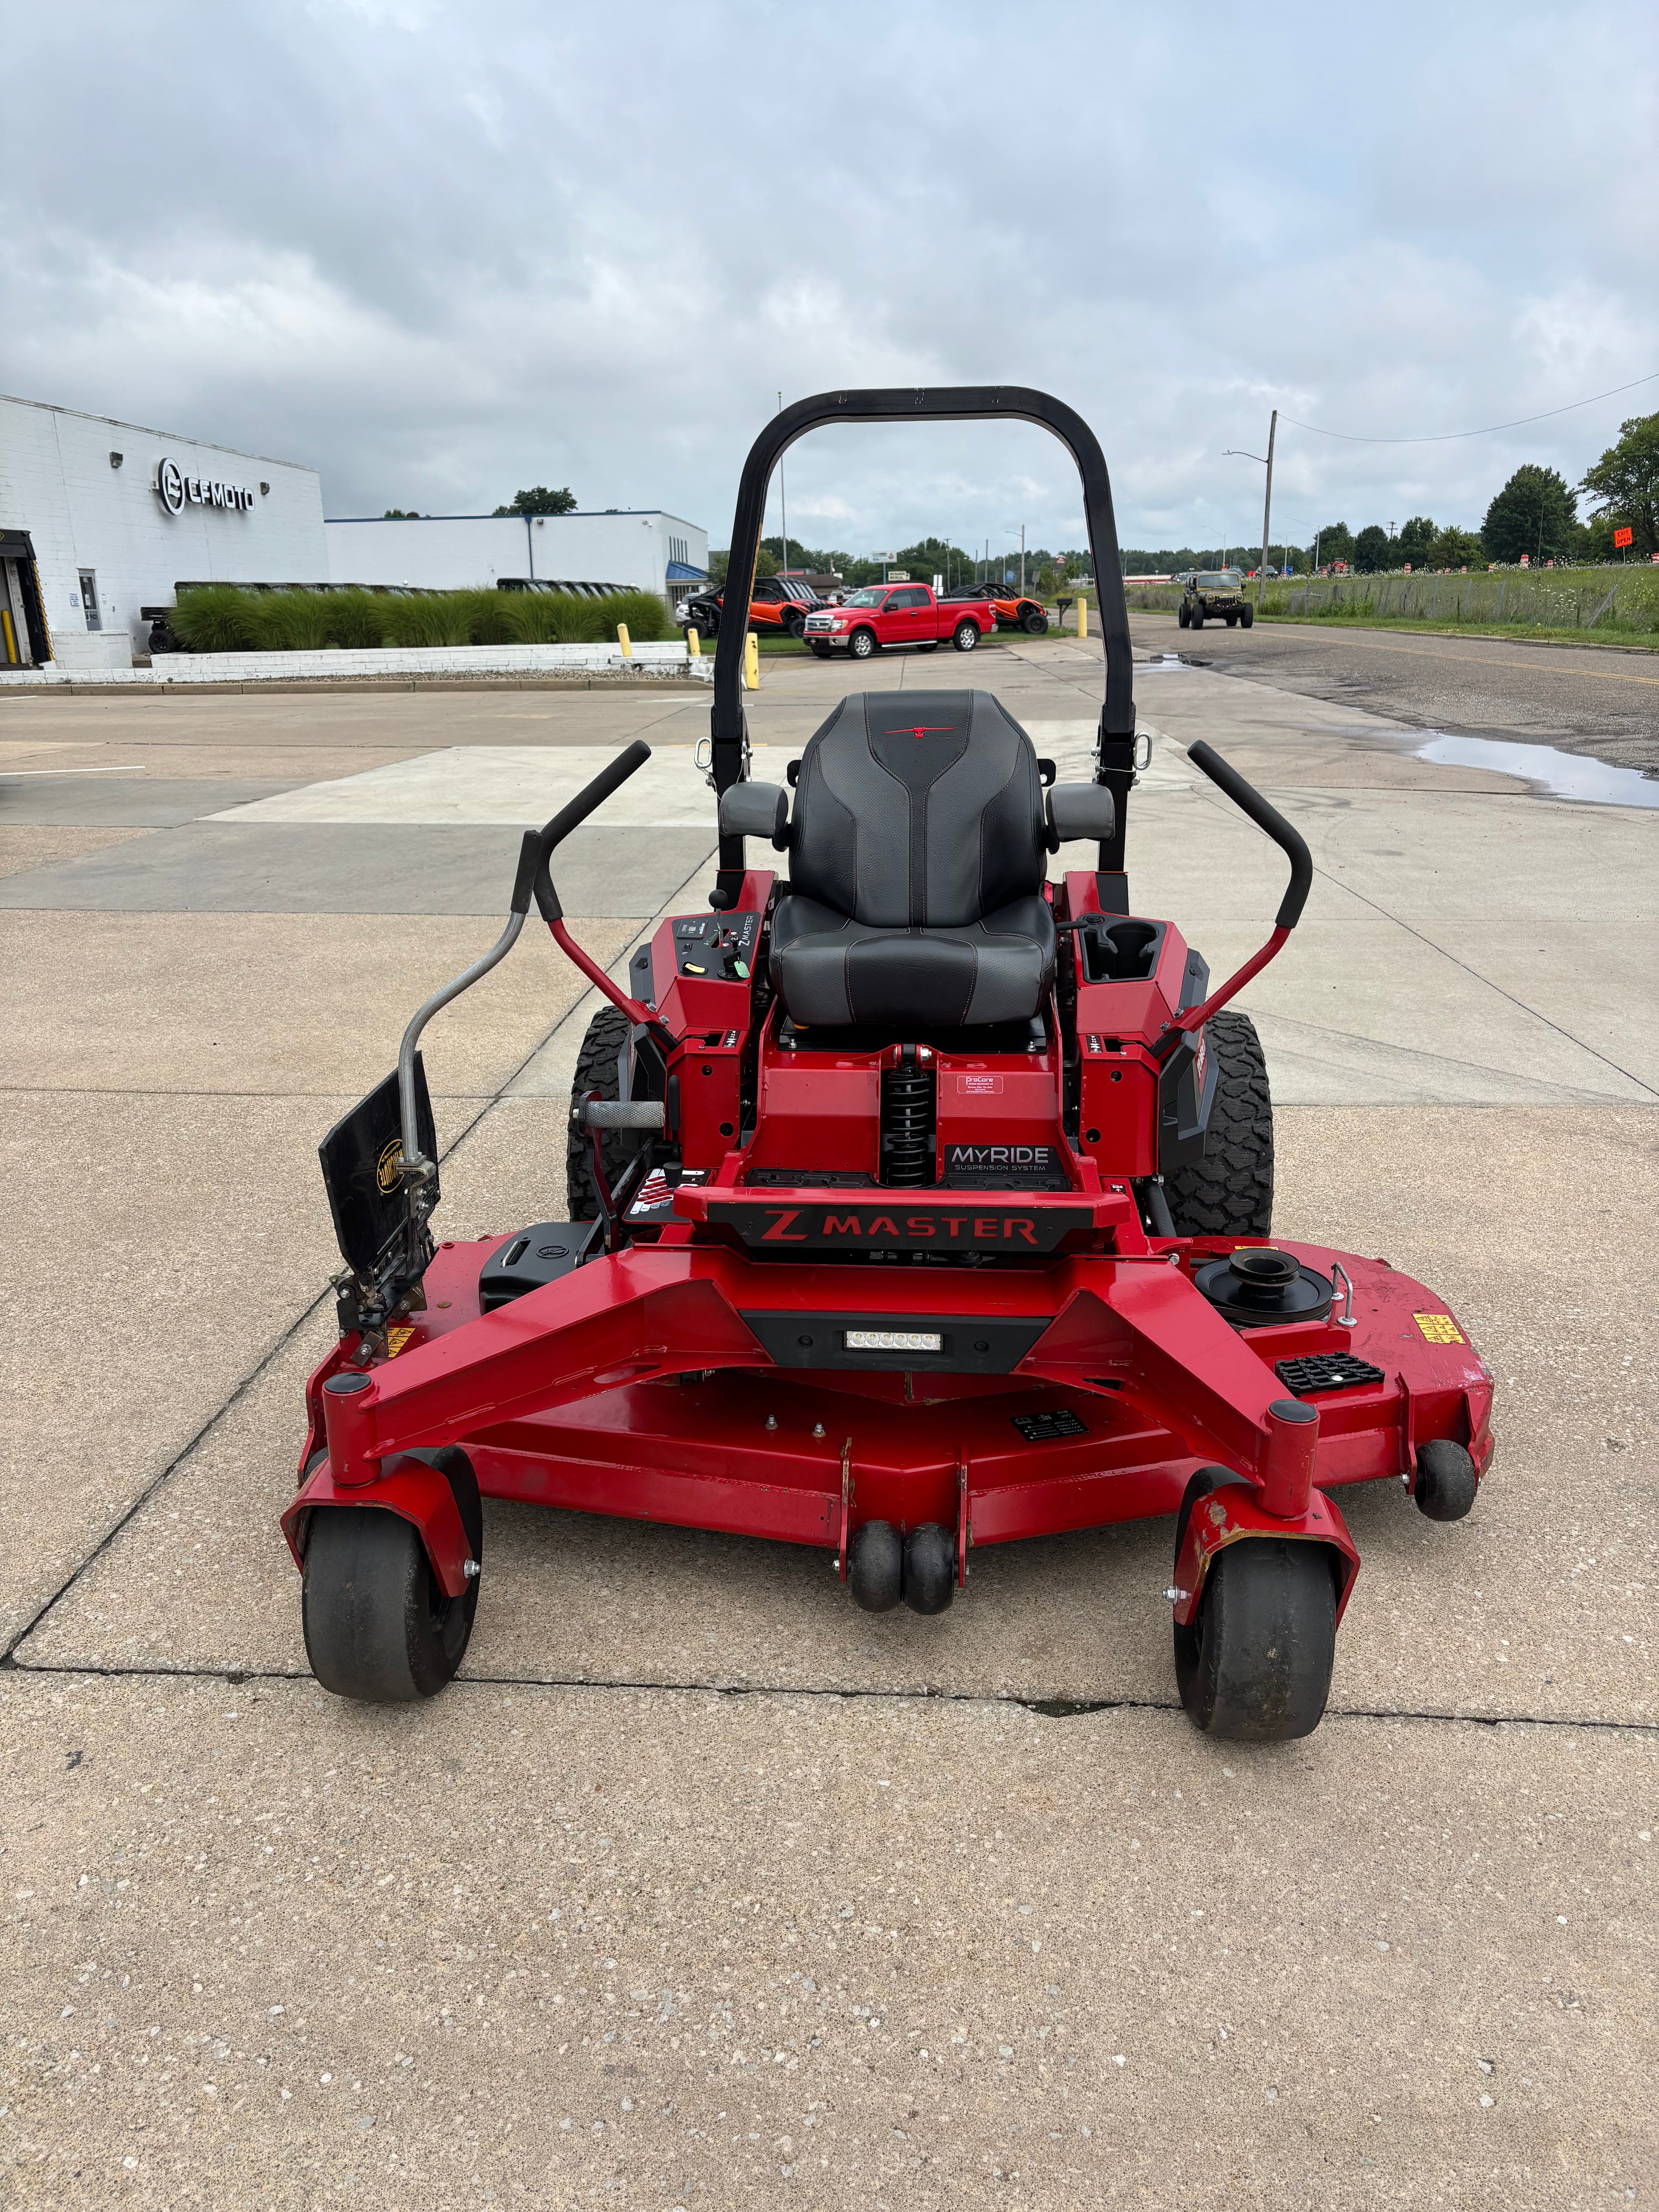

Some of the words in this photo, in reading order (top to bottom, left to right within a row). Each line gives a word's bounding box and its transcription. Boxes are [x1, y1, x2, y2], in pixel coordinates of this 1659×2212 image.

[185, 477, 255, 511] CFMOTO
[761, 1210, 809, 1240] Z
[822, 1215, 1039, 1245] MASTER
